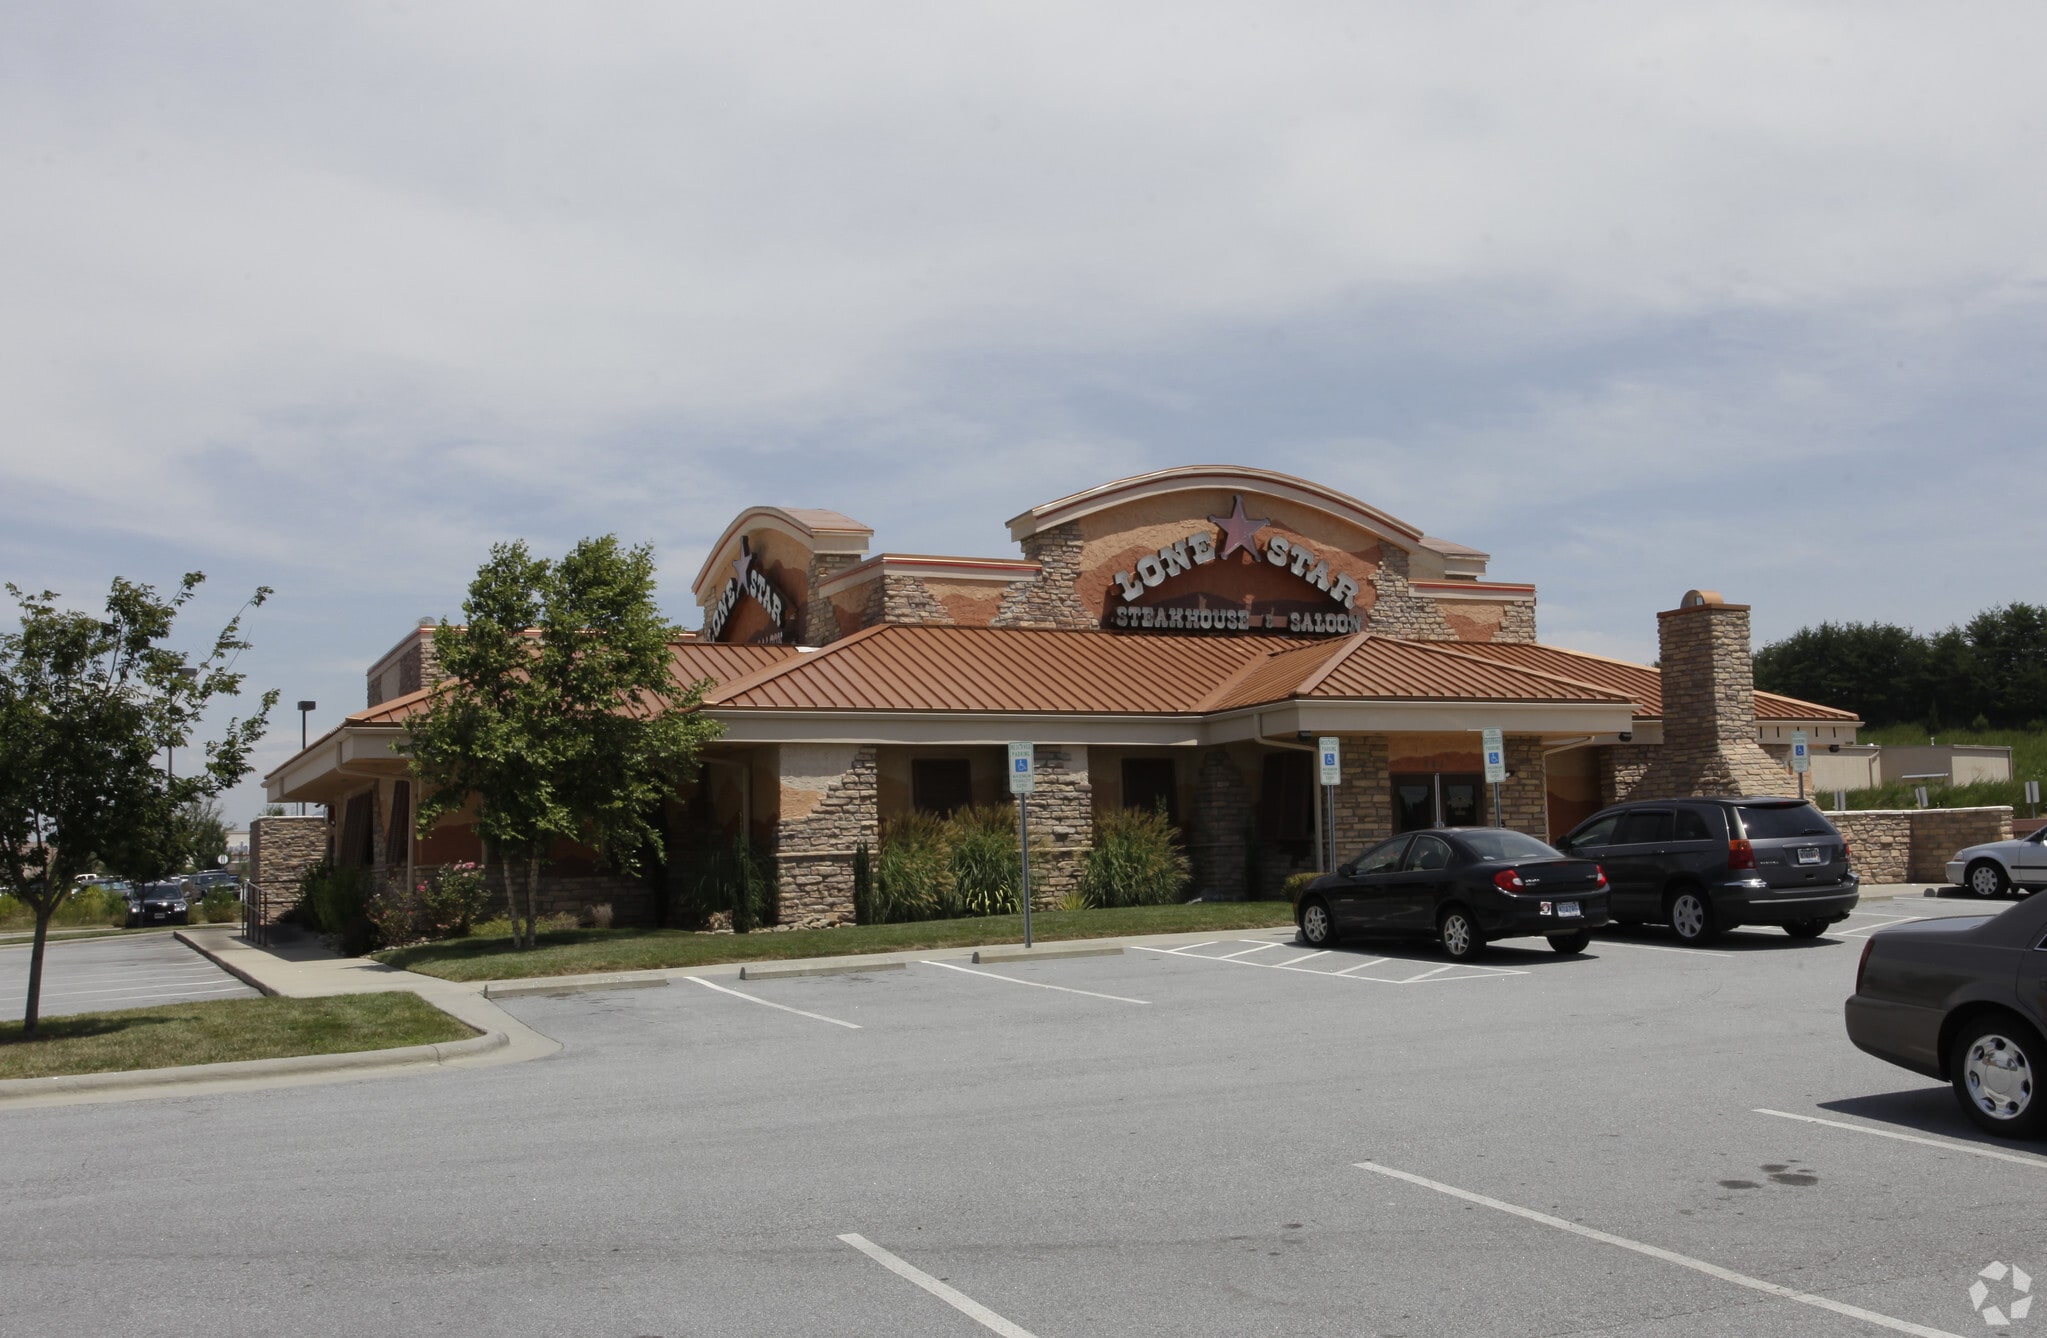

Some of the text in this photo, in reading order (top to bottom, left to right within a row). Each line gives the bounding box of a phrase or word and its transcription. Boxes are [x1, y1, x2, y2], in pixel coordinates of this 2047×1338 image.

[750, 569, 781, 627] STAR
[1113, 531, 1360, 609] LONE STAR
[1116, 606, 1250, 631] STEAKHOUSE
[1290, 611, 1362, 633] SALOON
